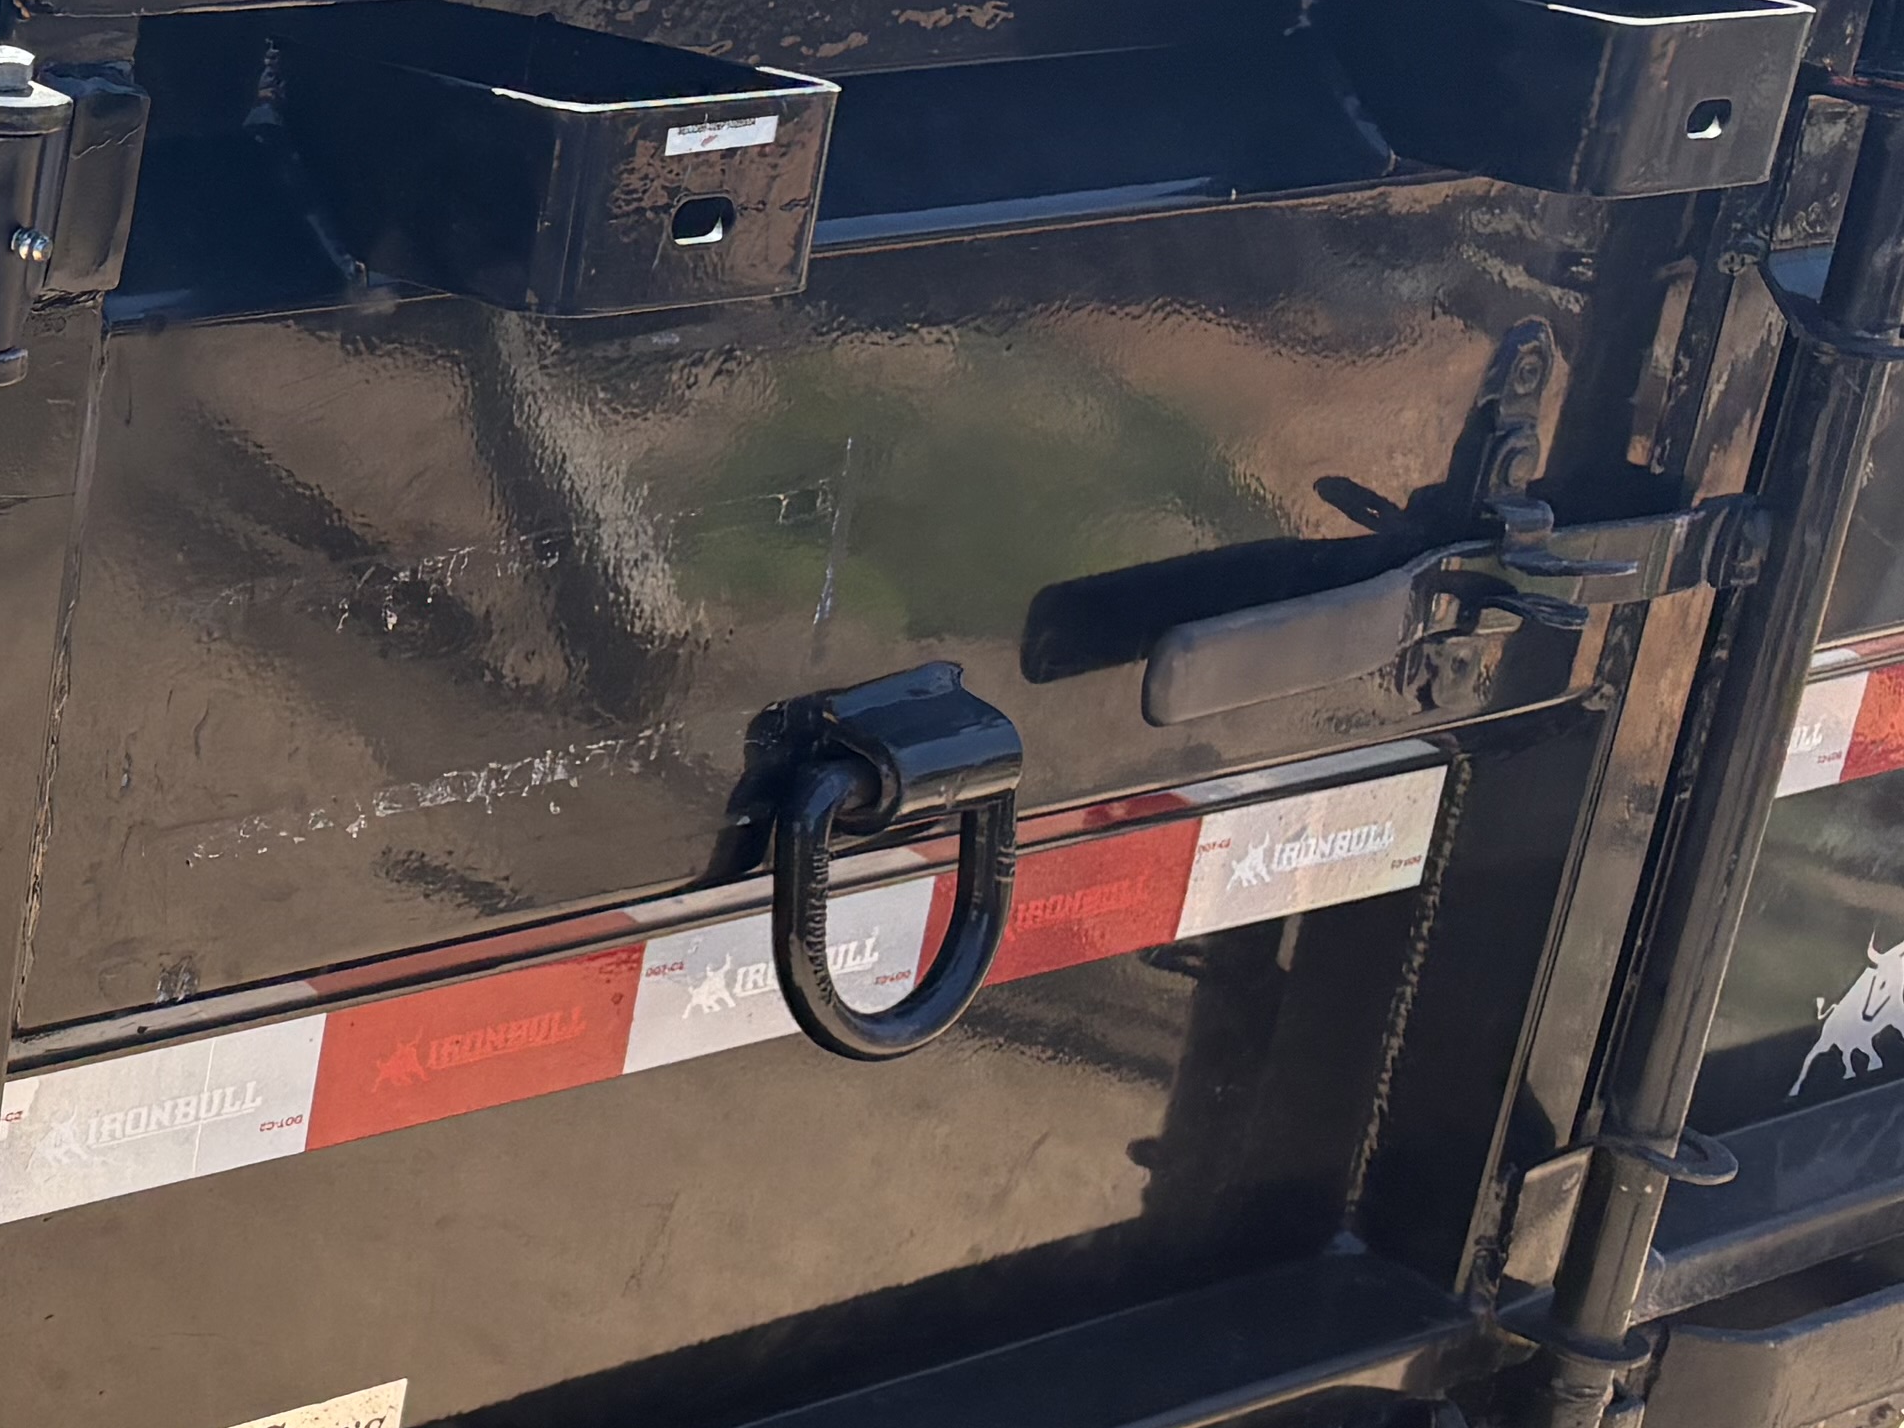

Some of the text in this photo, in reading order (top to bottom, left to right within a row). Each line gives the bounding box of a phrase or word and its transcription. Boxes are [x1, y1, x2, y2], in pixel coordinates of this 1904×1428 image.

[1272, 819, 1394, 872] IRONBULL
[427, 1006, 587, 1070] IRONBULL
[87, 1080, 264, 1148] IRONBULL
